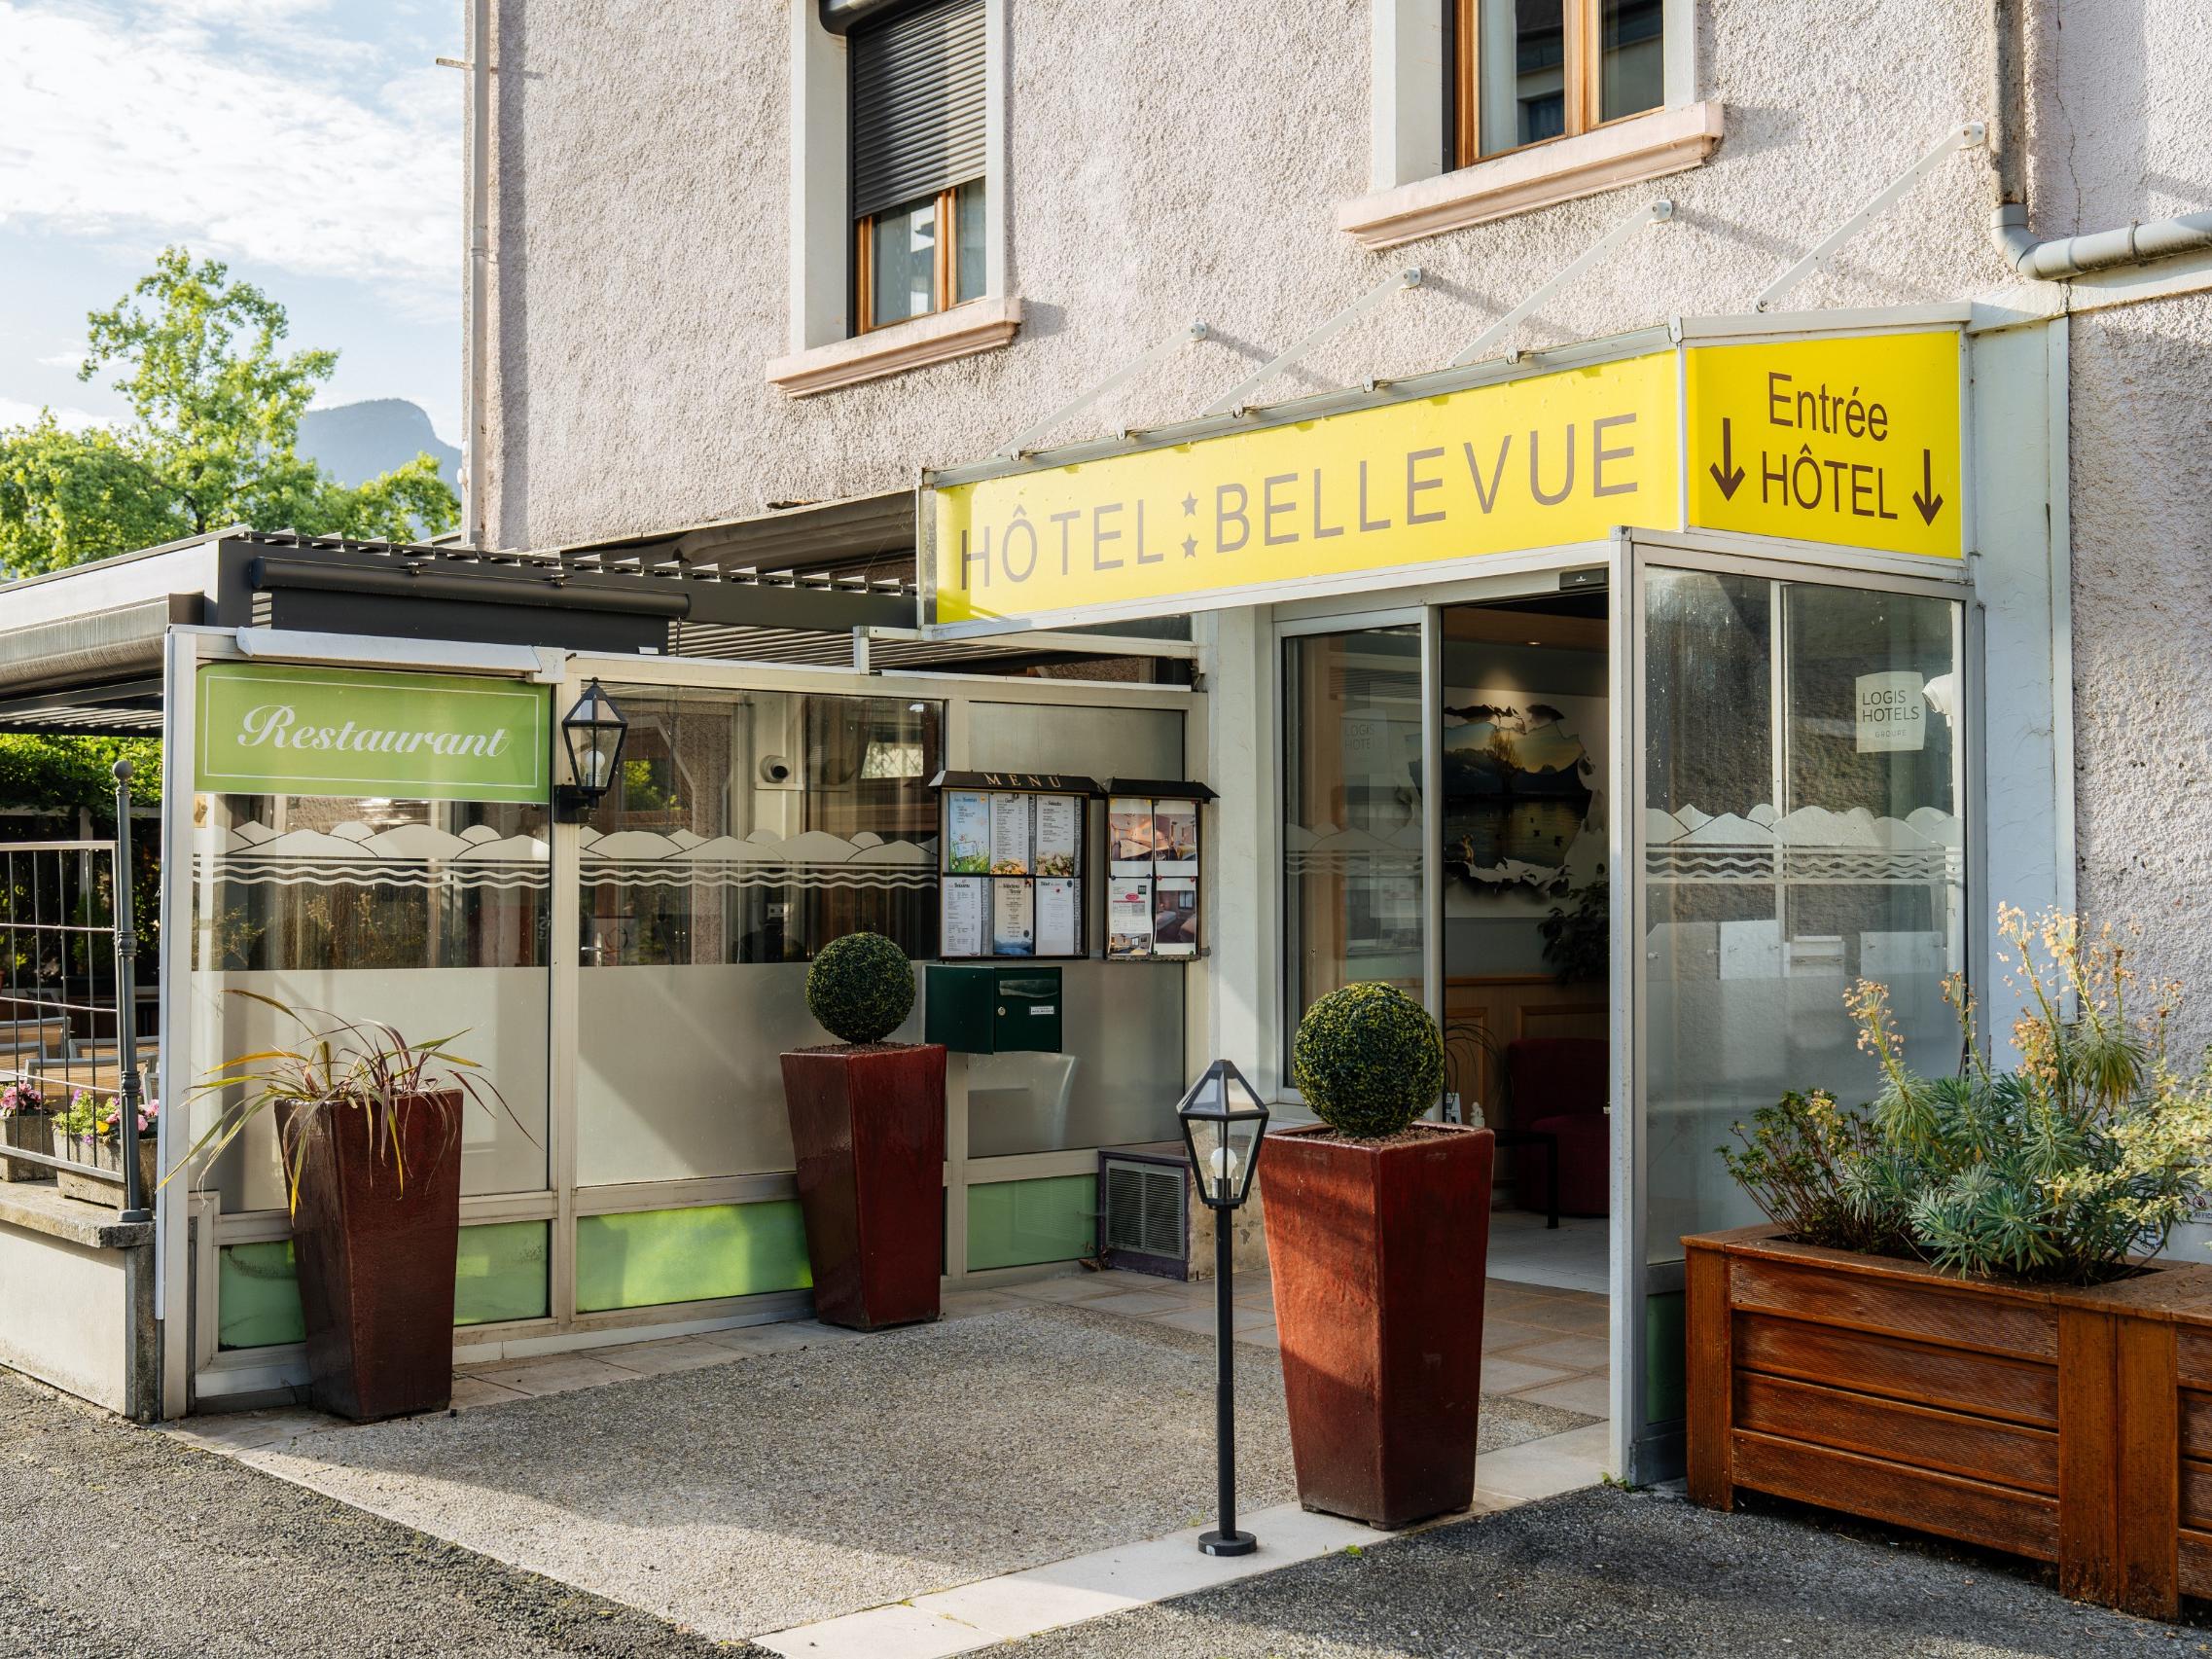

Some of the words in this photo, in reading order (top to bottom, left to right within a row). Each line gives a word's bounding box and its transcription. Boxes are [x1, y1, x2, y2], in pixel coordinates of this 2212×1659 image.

[1767, 371, 1888, 442] Entrée
[1762, 443, 1899, 521] HÔTEL
[960, 497, 1165, 592] HÔTEL
[1216, 412, 1640, 555] BELLEVUE
[1862, 689, 1907, 705] LOGIS
[1862, 705, 1920, 723] HOTELS
[236, 703, 513, 758] Restaurant
[1874, 729, 1908, 739] GROUPE
[982, 772, 1062, 788] MENU
